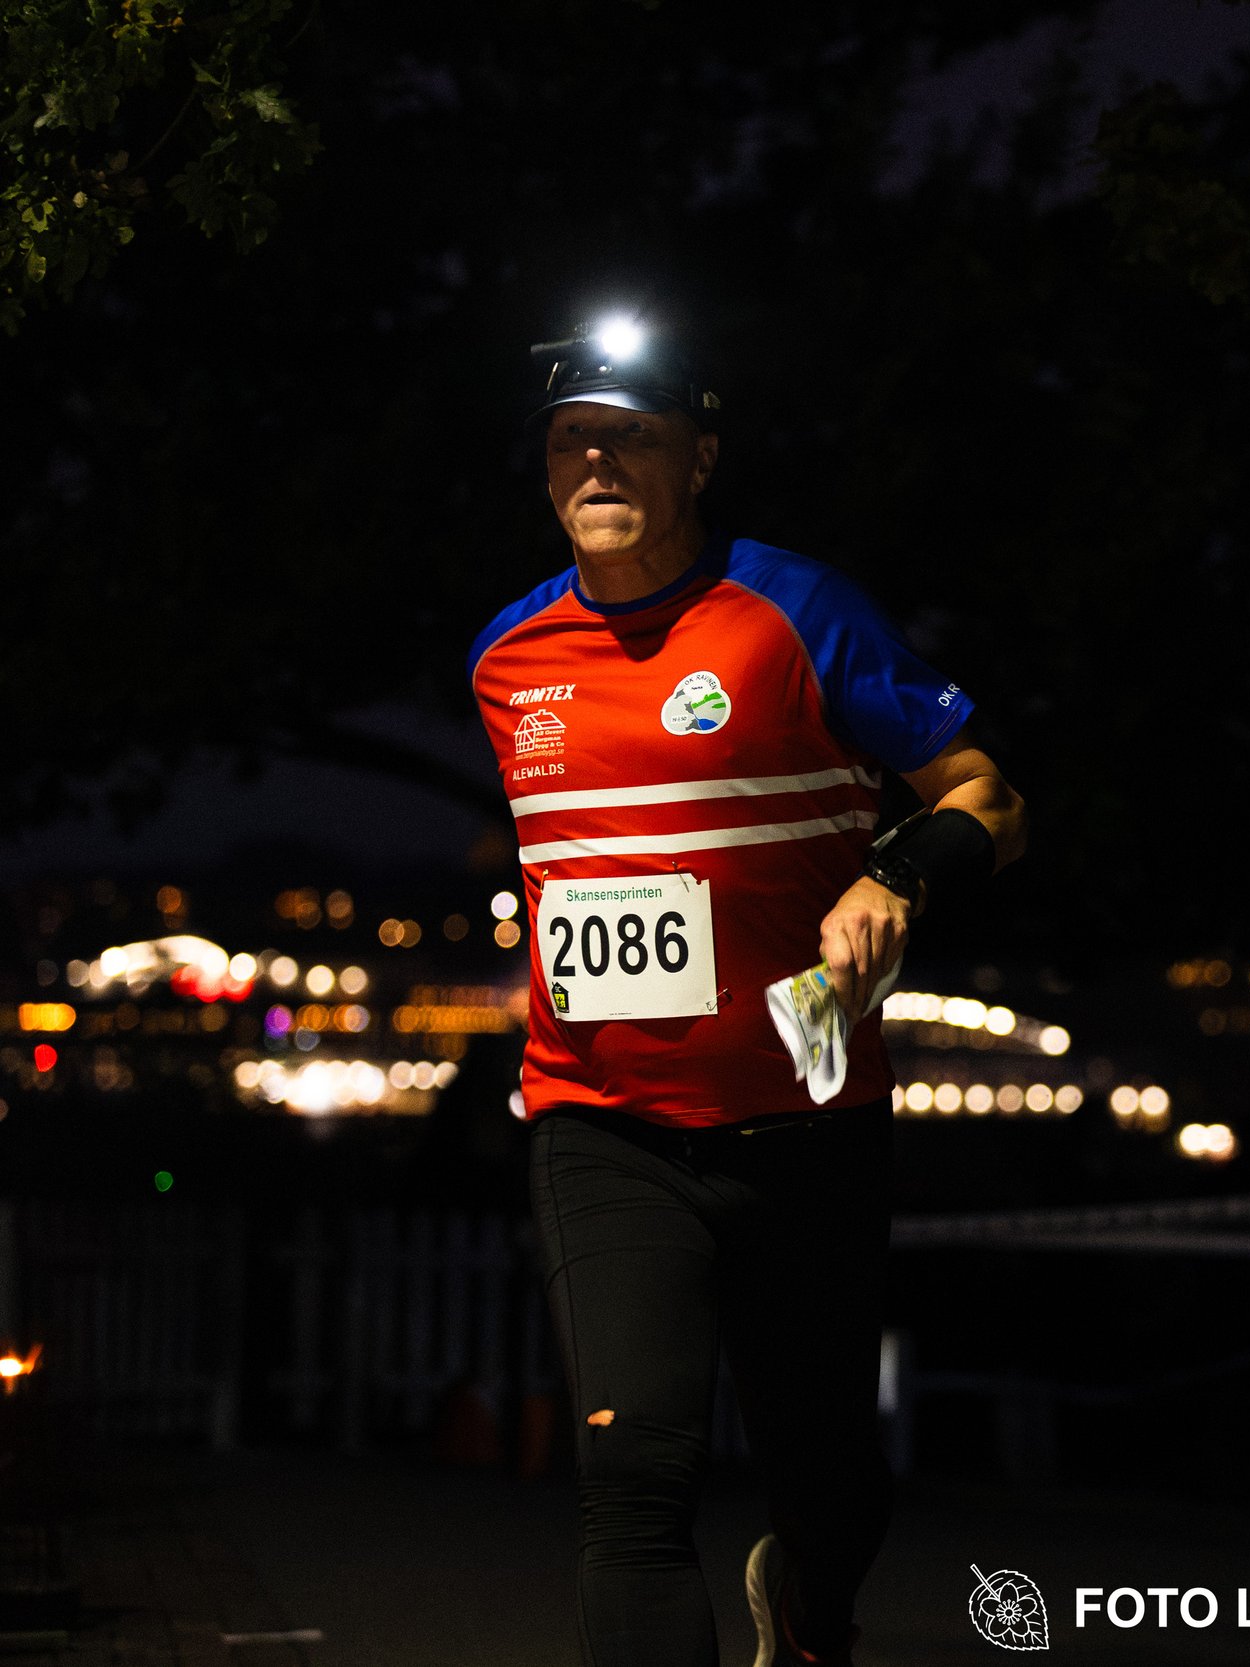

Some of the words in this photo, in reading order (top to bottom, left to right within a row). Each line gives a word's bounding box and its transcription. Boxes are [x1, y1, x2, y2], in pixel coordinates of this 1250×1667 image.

[684, 677, 694, 686] OK
[696, 674, 718, 690] RAVINEN
[509, 684, 576, 706] TRIMTEX
[938, 690, 955, 707] OK
[512, 764, 566, 781] ALEWALDS
[566, 886, 663, 902] Skansensprinten
[549, 911, 689, 977] 2086
